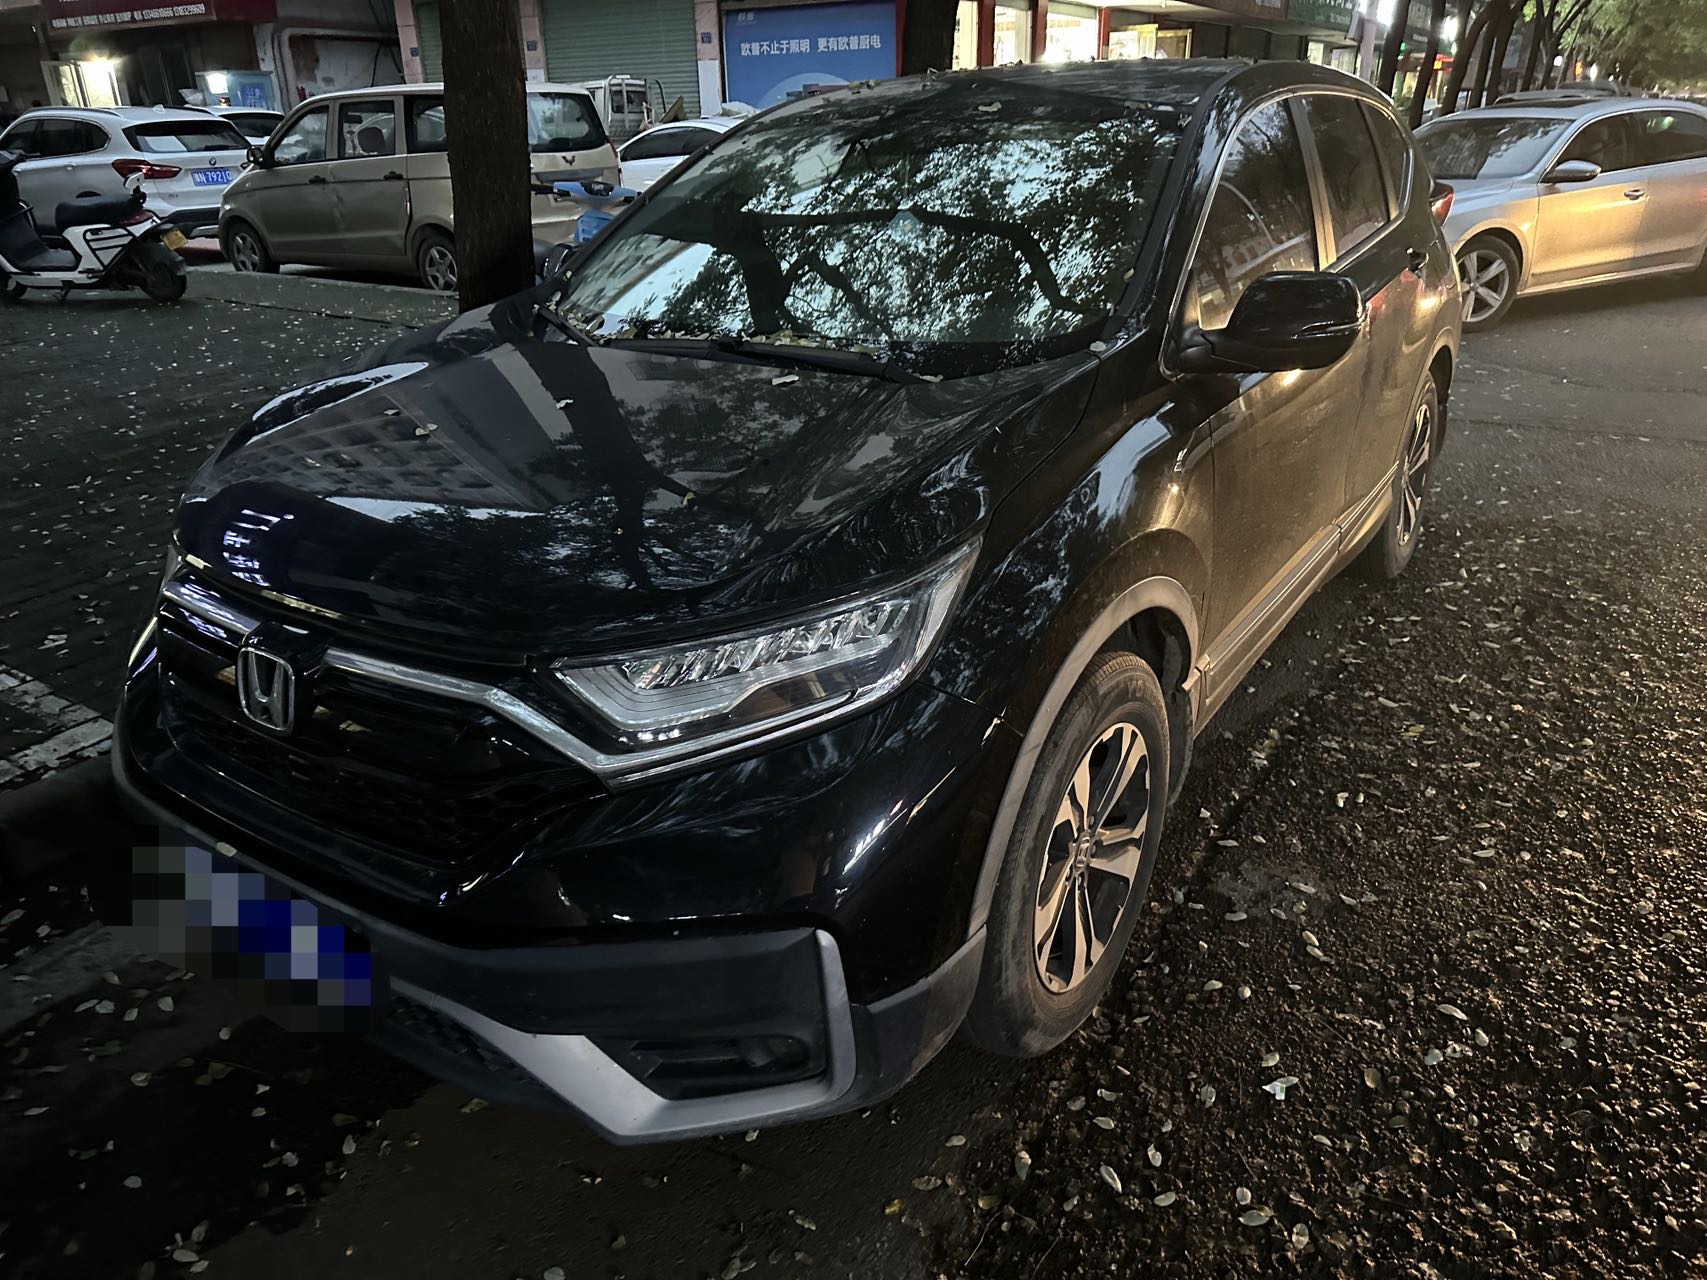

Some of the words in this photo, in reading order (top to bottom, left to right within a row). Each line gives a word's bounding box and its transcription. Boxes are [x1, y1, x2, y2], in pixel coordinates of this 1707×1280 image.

[741, 39, 810, 56] 欧普不止于照明
[817, 34, 881, 52] 更有欧普厨电
